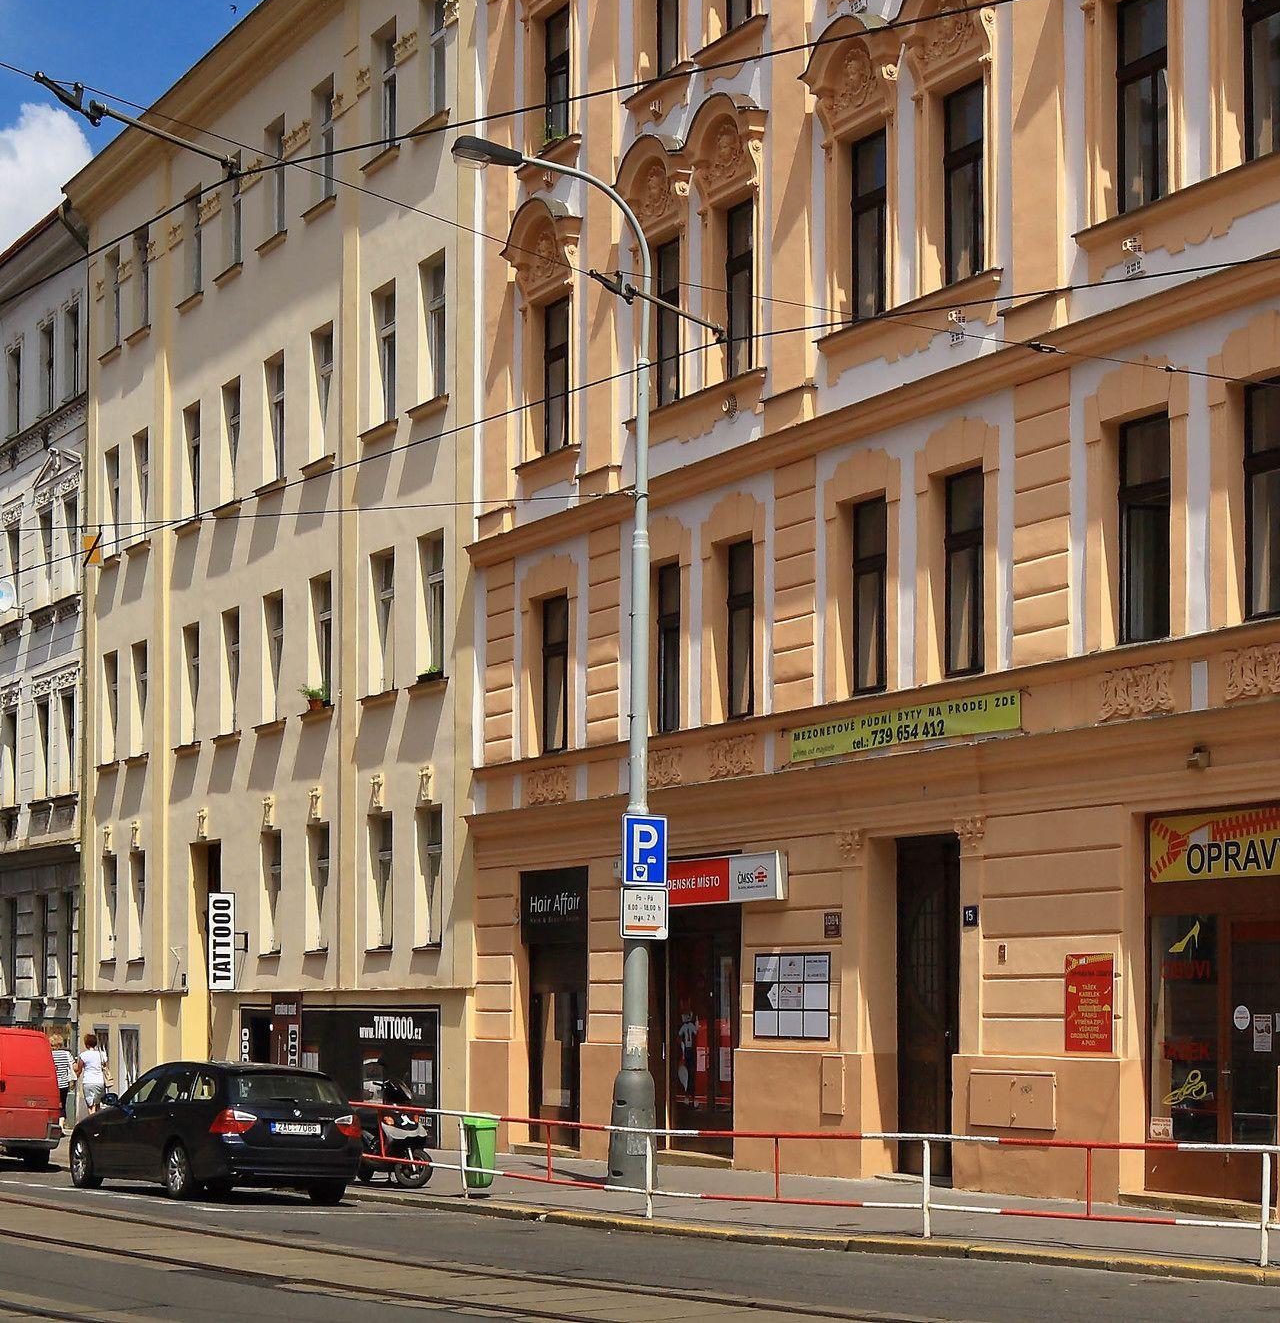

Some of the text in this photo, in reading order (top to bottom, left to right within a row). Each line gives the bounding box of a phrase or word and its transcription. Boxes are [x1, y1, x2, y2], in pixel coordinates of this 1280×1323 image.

[793, 721, 855, 741] MEZONETOVÉ
[898, 709, 922, 721] BYTY
[928, 707, 942, 717] NA
[948, 699, 988, 714] PRODEJ
[994, 695, 1016, 708] ZDE
[871, 728, 893, 746] 739
[897, 724, 919, 743] 654
[922, 719, 945, 738] 412
[633, 824, 658, 863] P
[697, 875, 720, 888] MÍSTO
[530, 892, 580, 915] Hair Affair
[966, 910, 974, 921] 15
[213, 899, 231, 983] TATTOOO
